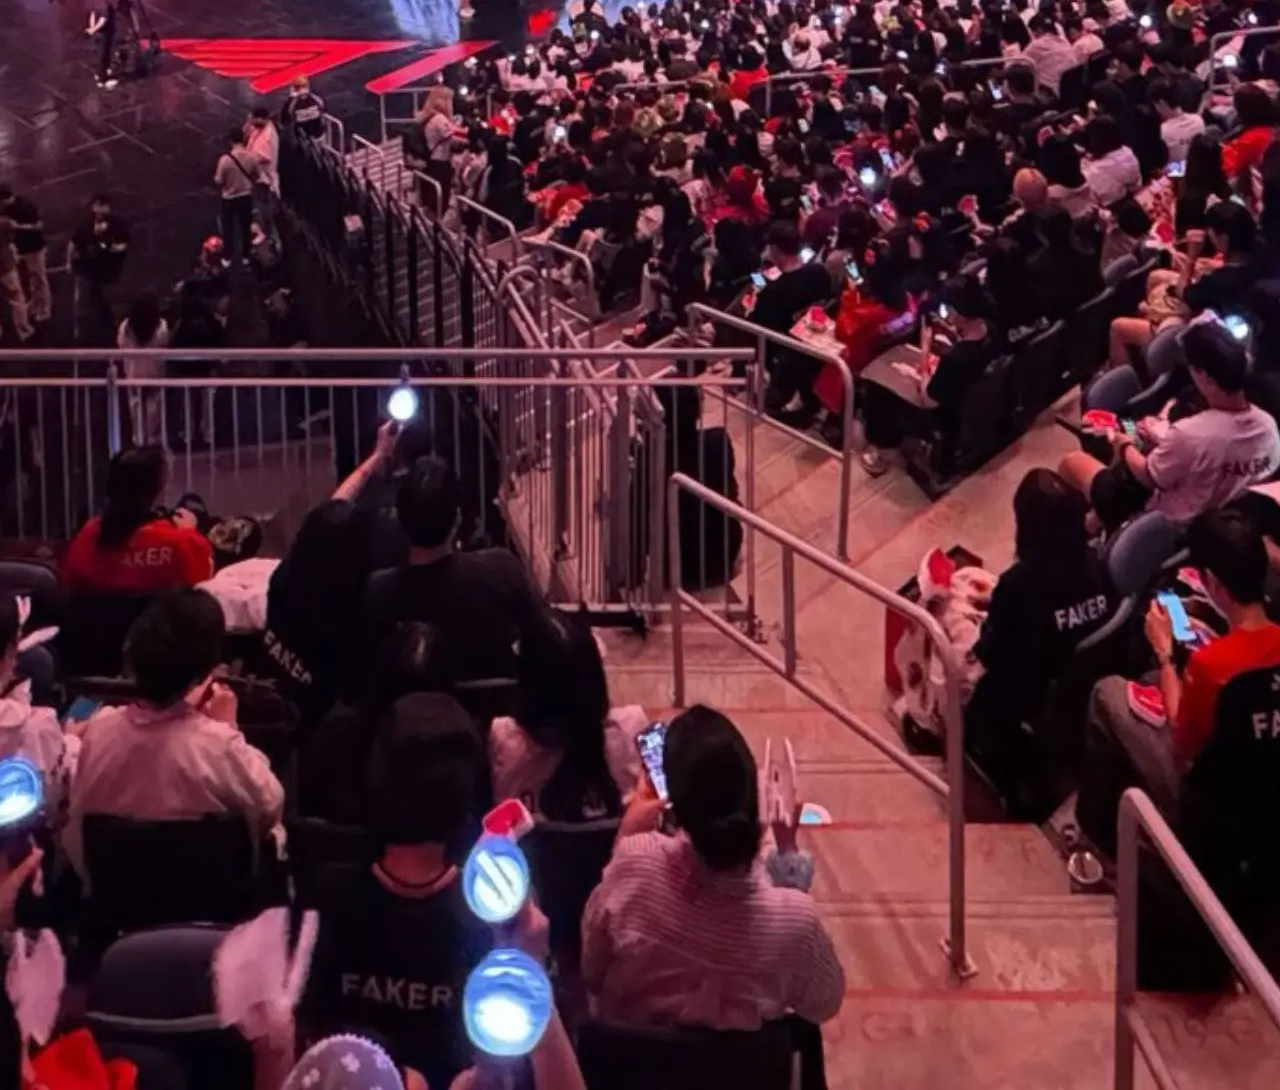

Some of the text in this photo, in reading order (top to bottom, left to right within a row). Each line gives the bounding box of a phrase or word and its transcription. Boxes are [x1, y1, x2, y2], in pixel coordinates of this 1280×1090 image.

[1221, 456, 1272, 479] FAKER
[121, 546, 173, 568] AKER
[1054, 593, 1108, 632] FAKER
[264, 629, 313, 686] FAKER
[340, 972, 454, 1010] FAKER
